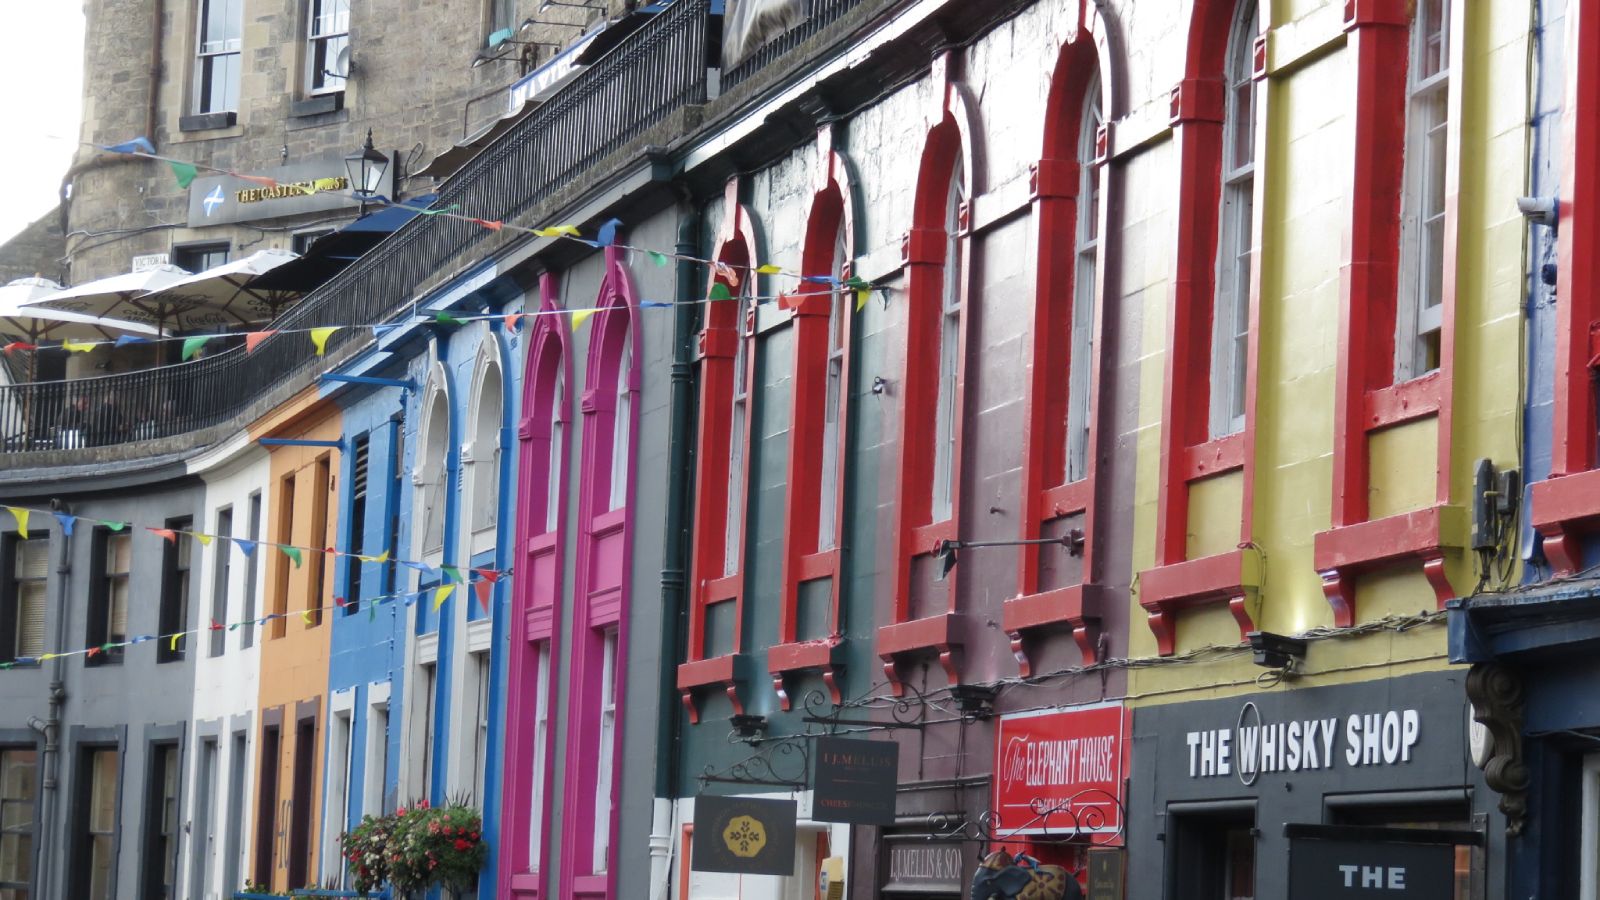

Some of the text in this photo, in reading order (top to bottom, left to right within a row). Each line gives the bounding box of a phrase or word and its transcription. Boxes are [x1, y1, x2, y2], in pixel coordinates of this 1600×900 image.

[234, 189, 257, 203] THE
[134, 256, 168, 267] VICTORIA
[1186, 729, 1232, 778] THE
[1239, 717, 1338, 775] WHISKY
[1346, 708, 1422, 767] SHOP
[1003, 733, 1115, 793] The ELEPHANT HOUSE
[936, 847, 943, 879] &
[1338, 864, 1407, 890] THE
